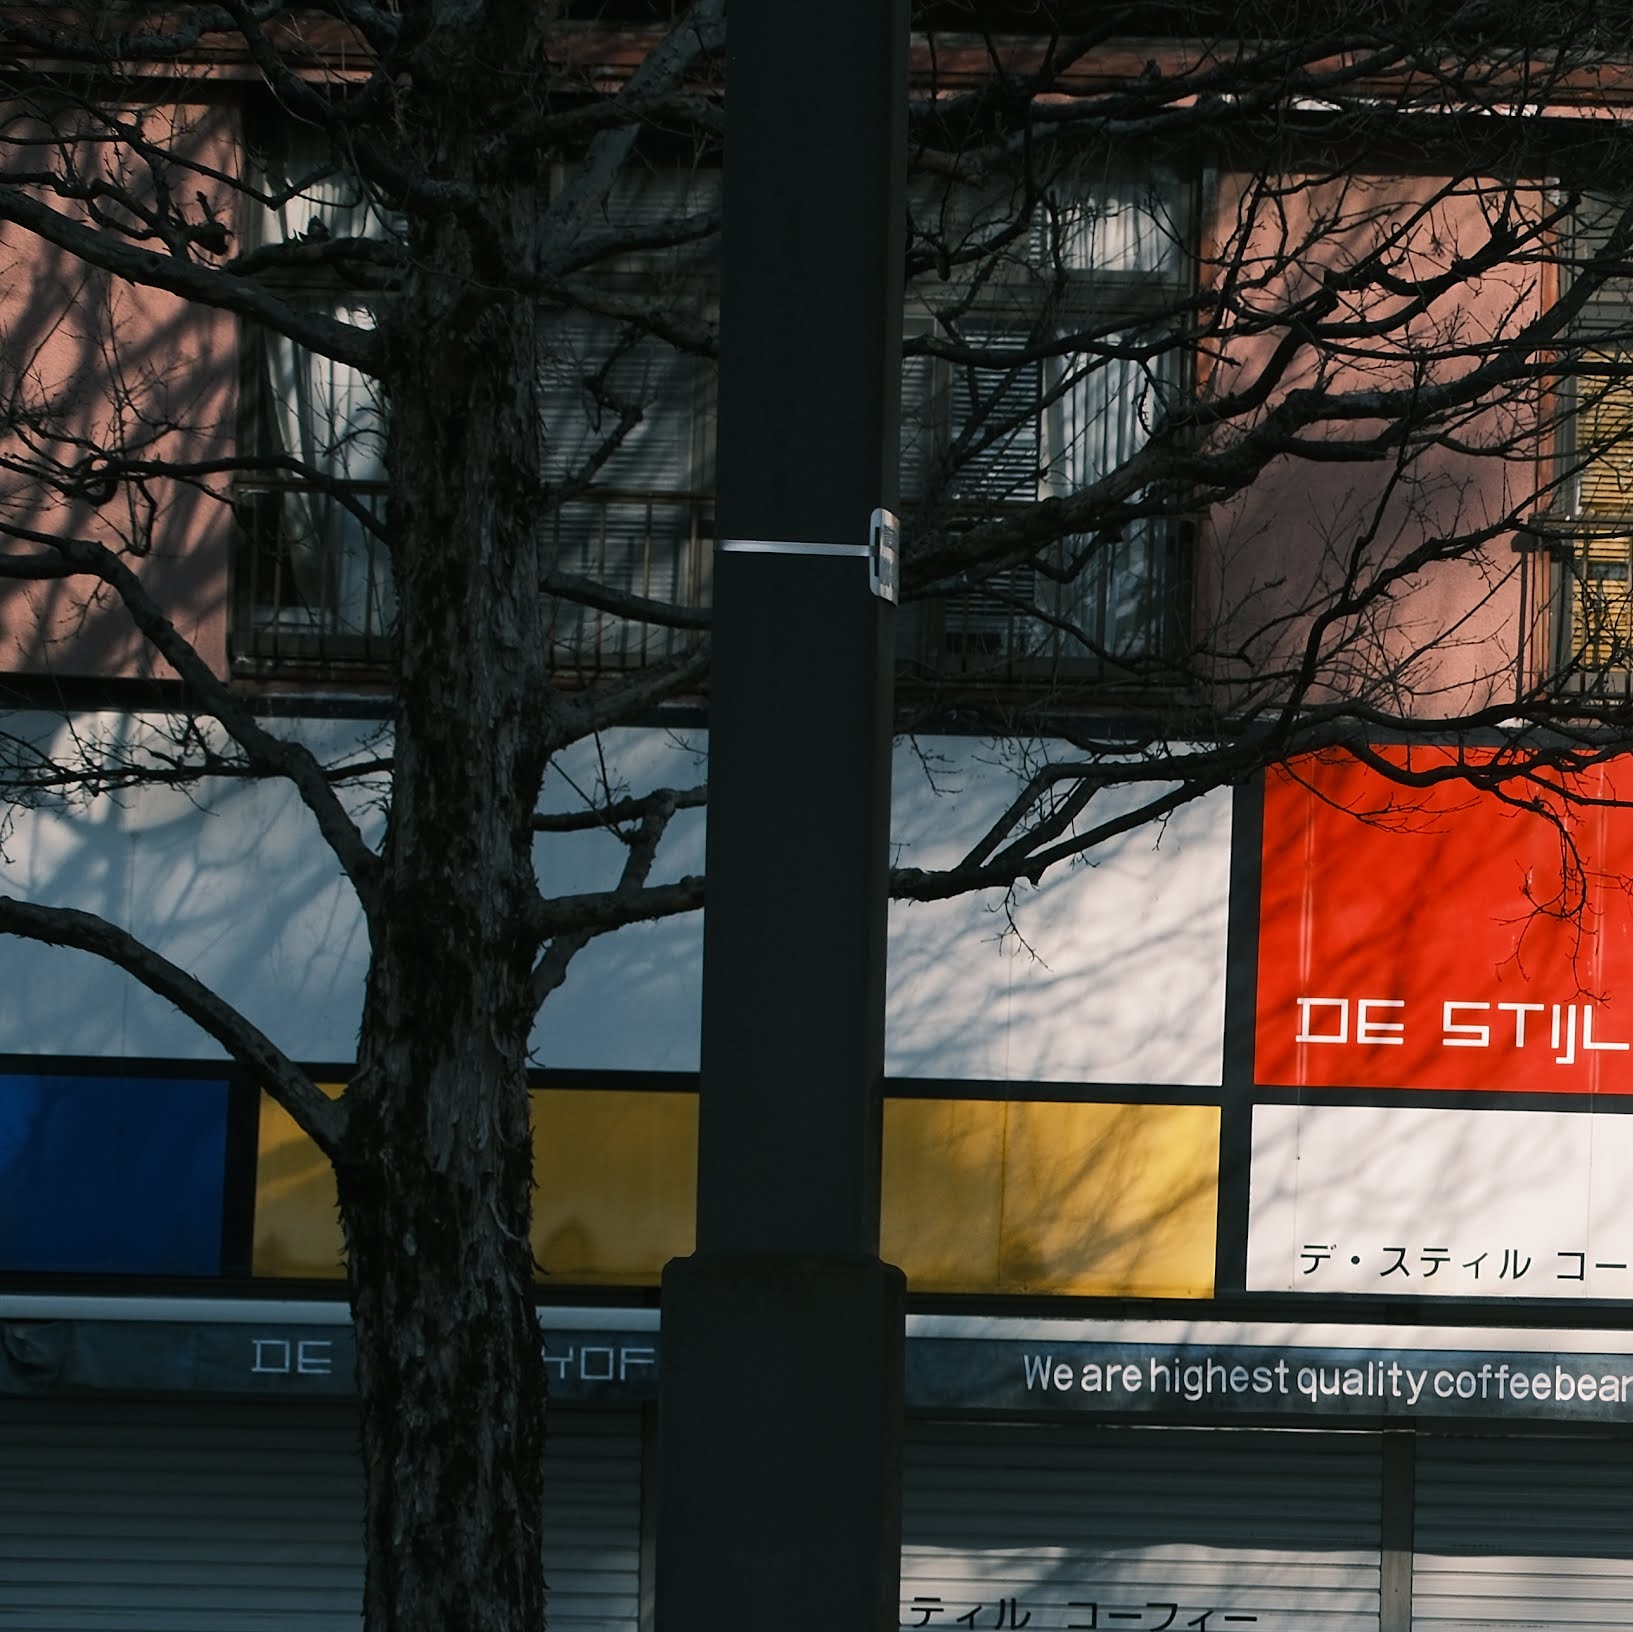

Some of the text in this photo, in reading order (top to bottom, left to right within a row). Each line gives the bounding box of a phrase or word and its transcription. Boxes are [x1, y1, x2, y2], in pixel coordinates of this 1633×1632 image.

[1296, 997, 1405, 1045] DE
[1442, 1001, 1630, 1064] STIJL
[1299, 1244, 1532, 1281] デ・スティル
[251, 1339, 333, 1374] DE
[1023, 1354, 1074, 1391] We
[1081, 1364, 1143, 1392] are
[1150, 1357, 1289, 1401] highest
[1297, 1361, 1428, 1404] quality
[898, 1597, 1031, 1630] ティル
